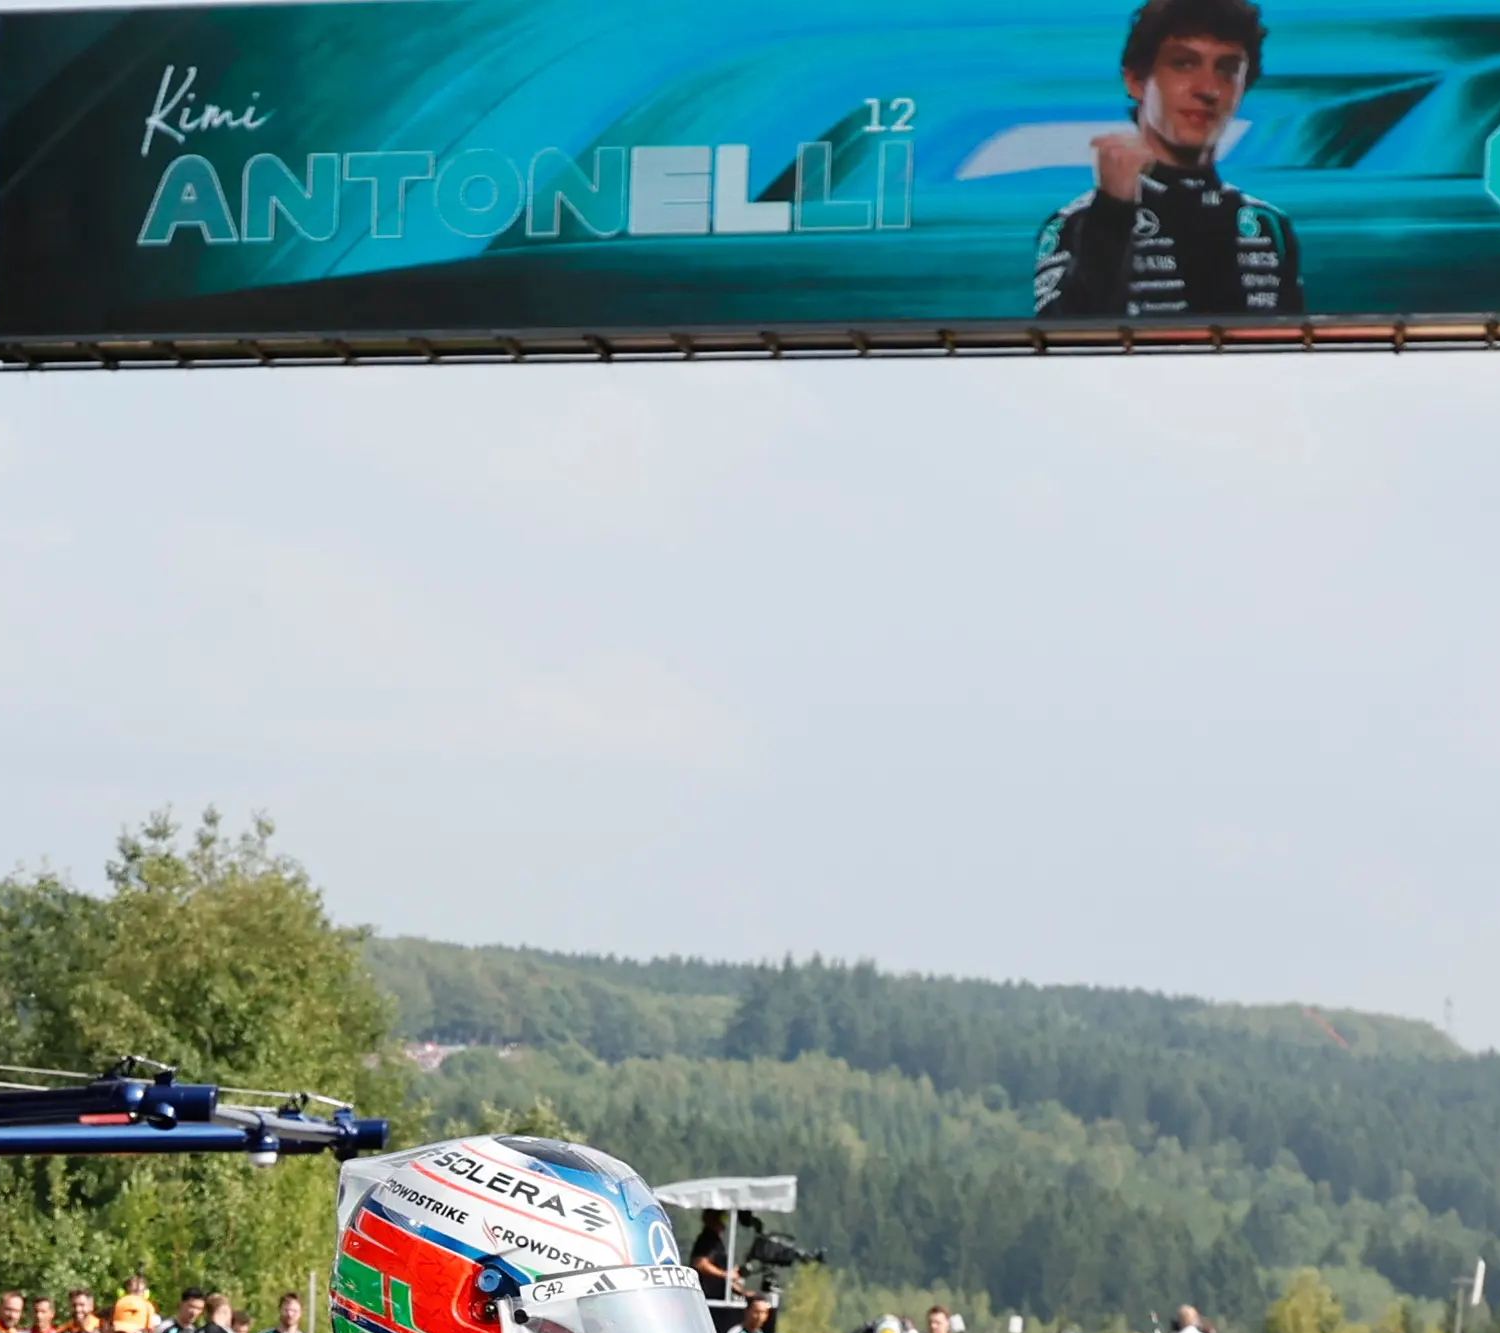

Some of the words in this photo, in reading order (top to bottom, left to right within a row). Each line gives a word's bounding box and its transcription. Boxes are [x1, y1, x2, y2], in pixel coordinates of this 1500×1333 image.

[140, 64, 269, 157] Kimi
[137, 140, 915, 246] ANTONELLI
[864, 97, 916, 132] 12
[434, 1151, 566, 1218] SOLERA
